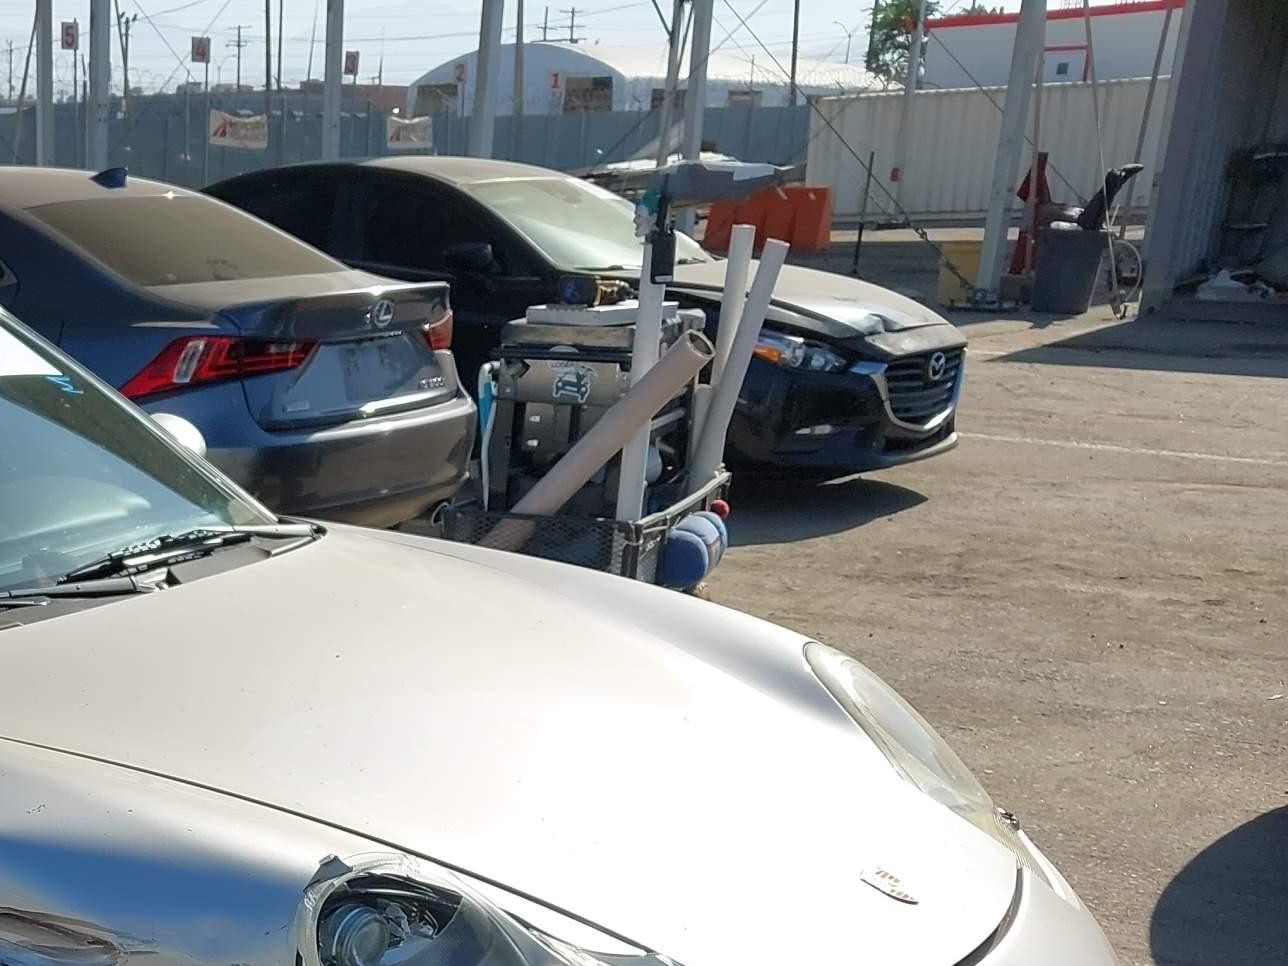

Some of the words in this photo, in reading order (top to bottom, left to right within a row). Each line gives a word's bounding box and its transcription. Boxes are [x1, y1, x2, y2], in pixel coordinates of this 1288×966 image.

[64, 25, 75, 48] 5
[195, 39, 206, 60] 4
[549, 72, 560, 89] 1
